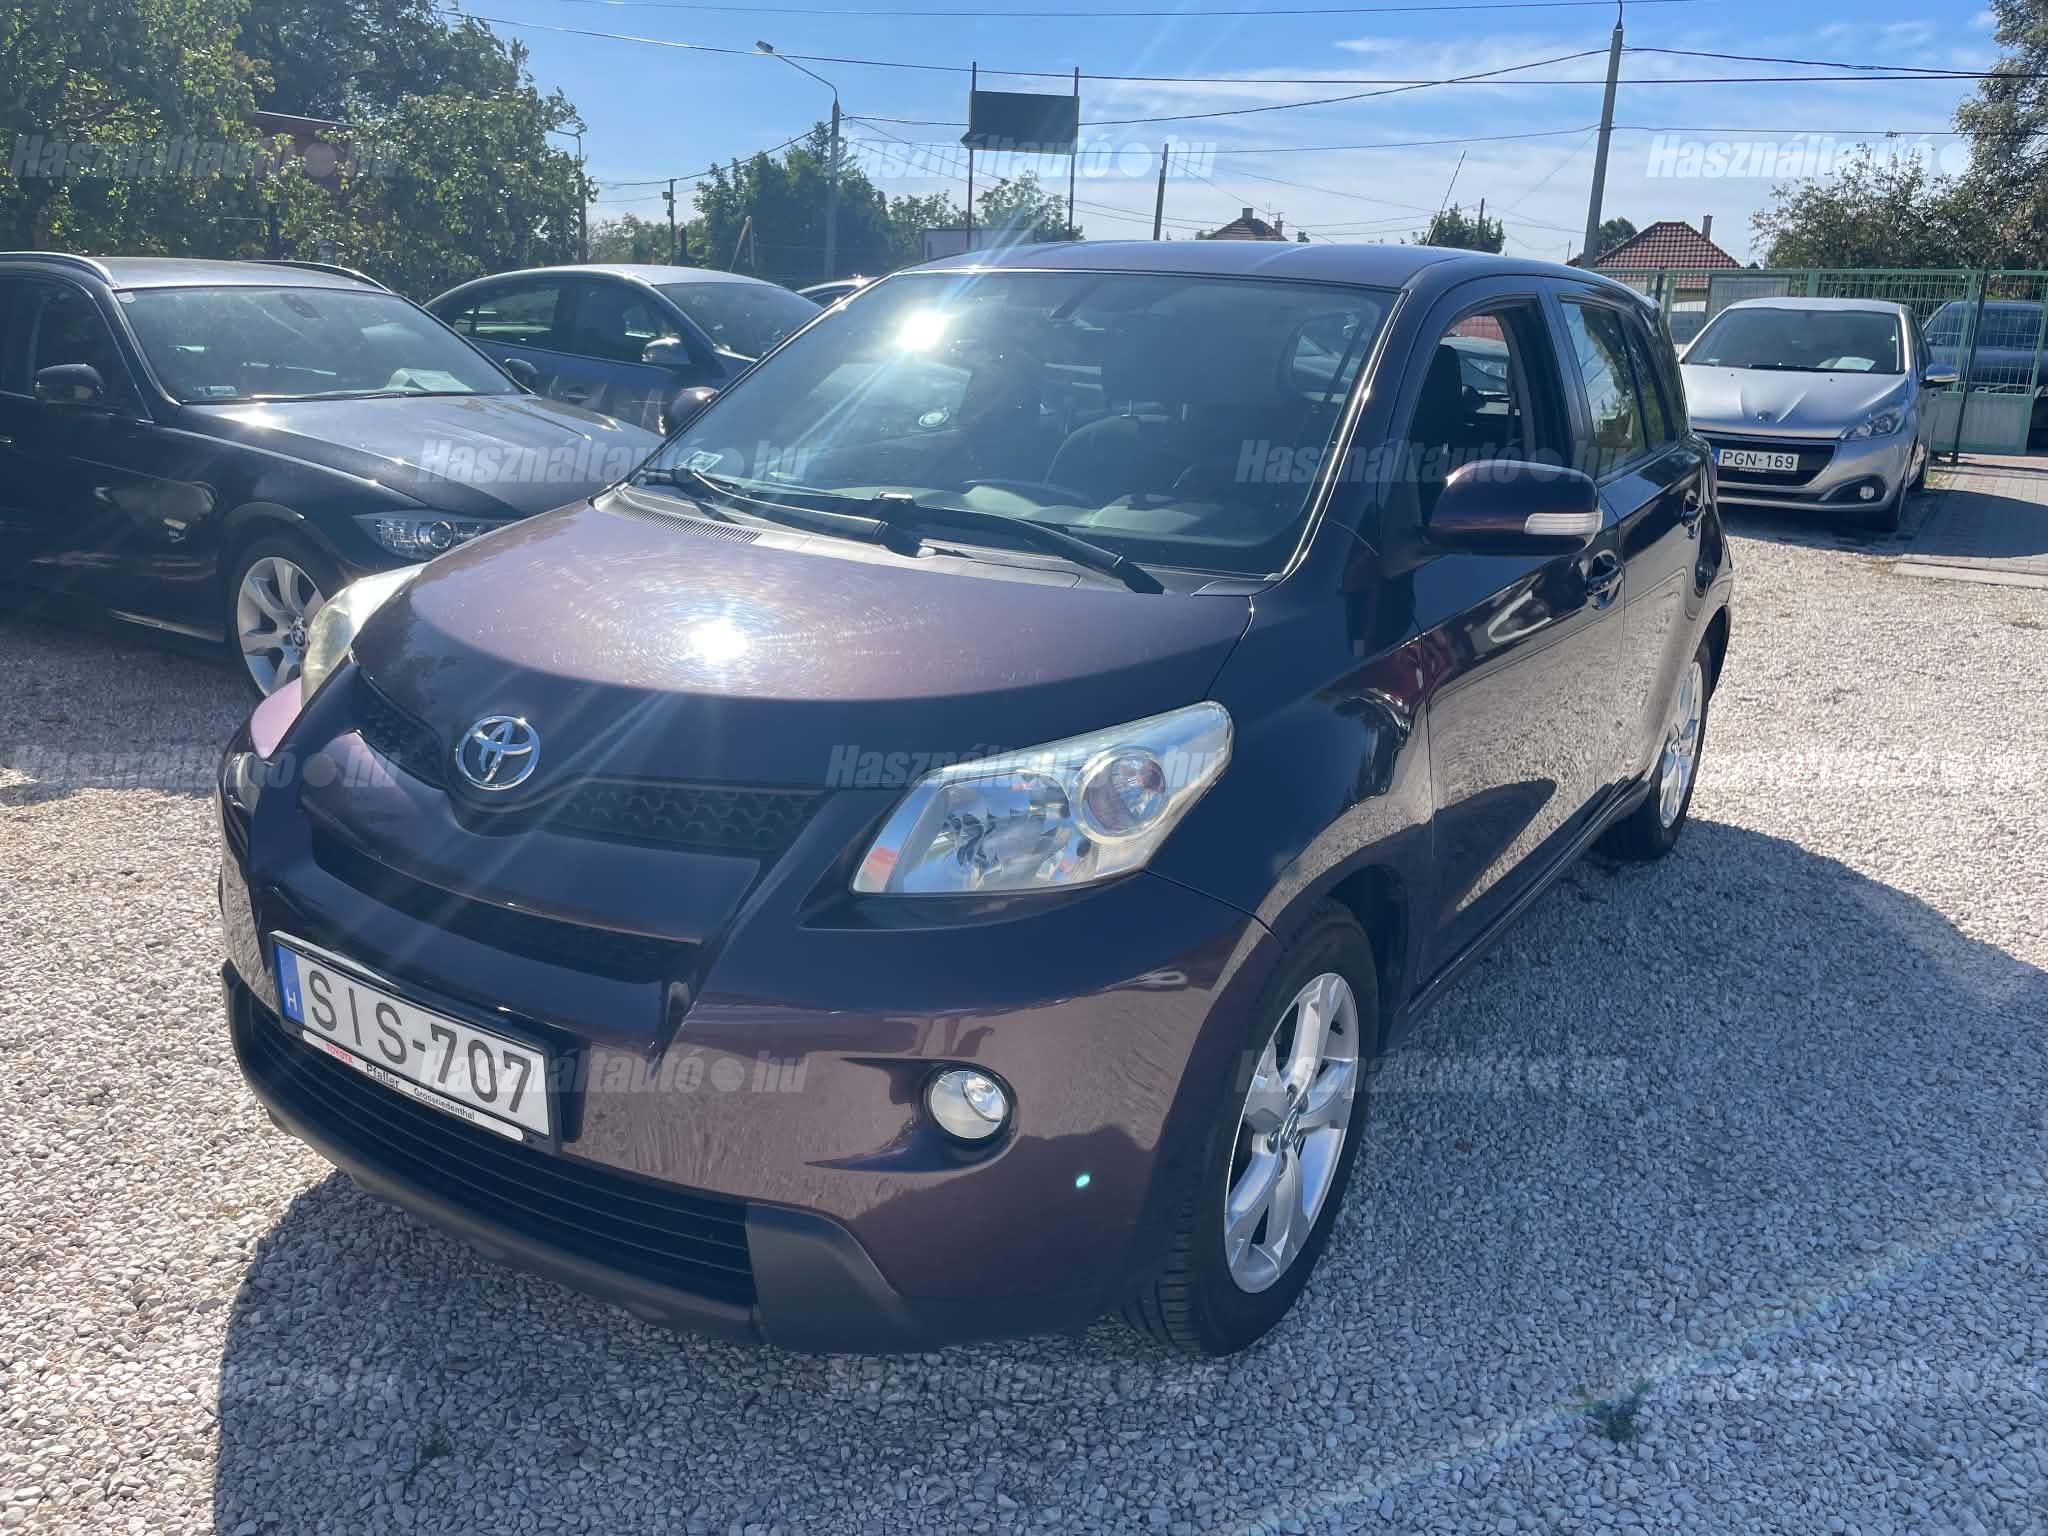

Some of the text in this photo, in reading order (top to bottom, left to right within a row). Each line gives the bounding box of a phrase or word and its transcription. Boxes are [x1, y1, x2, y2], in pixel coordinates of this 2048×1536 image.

[1722, 451, 1794, 469] PGN-169
[308, 970, 532, 1113] SIS-707
[366, 1063, 400, 1089] Pfaller
